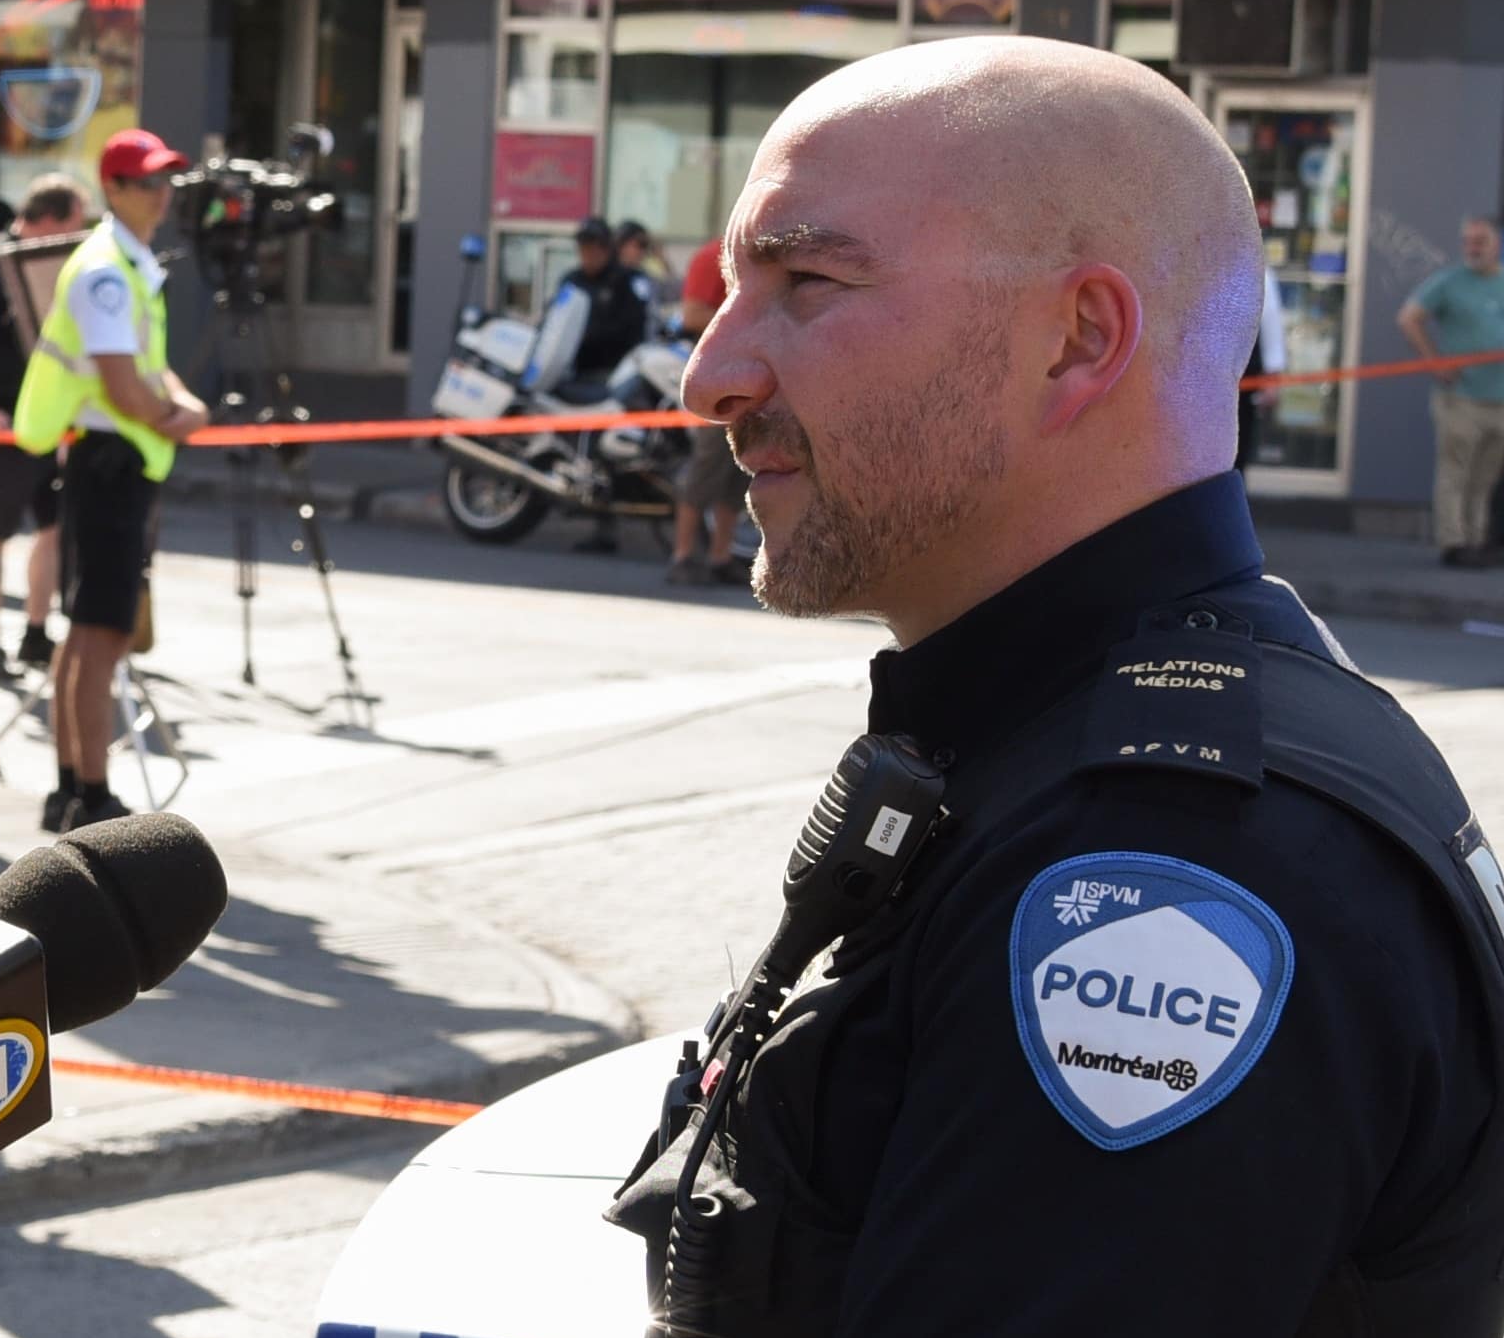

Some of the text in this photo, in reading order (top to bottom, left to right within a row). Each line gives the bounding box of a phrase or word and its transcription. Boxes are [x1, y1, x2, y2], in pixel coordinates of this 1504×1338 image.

[1116, 660, 1246, 678] RELATIONS
[1134, 673, 1224, 691] MÉDIAS
[1087, 880, 1142, 906] SPVM
[1041, 963, 1241, 1038] POLICE
[1057, 1041, 1165, 1081] Montréal
